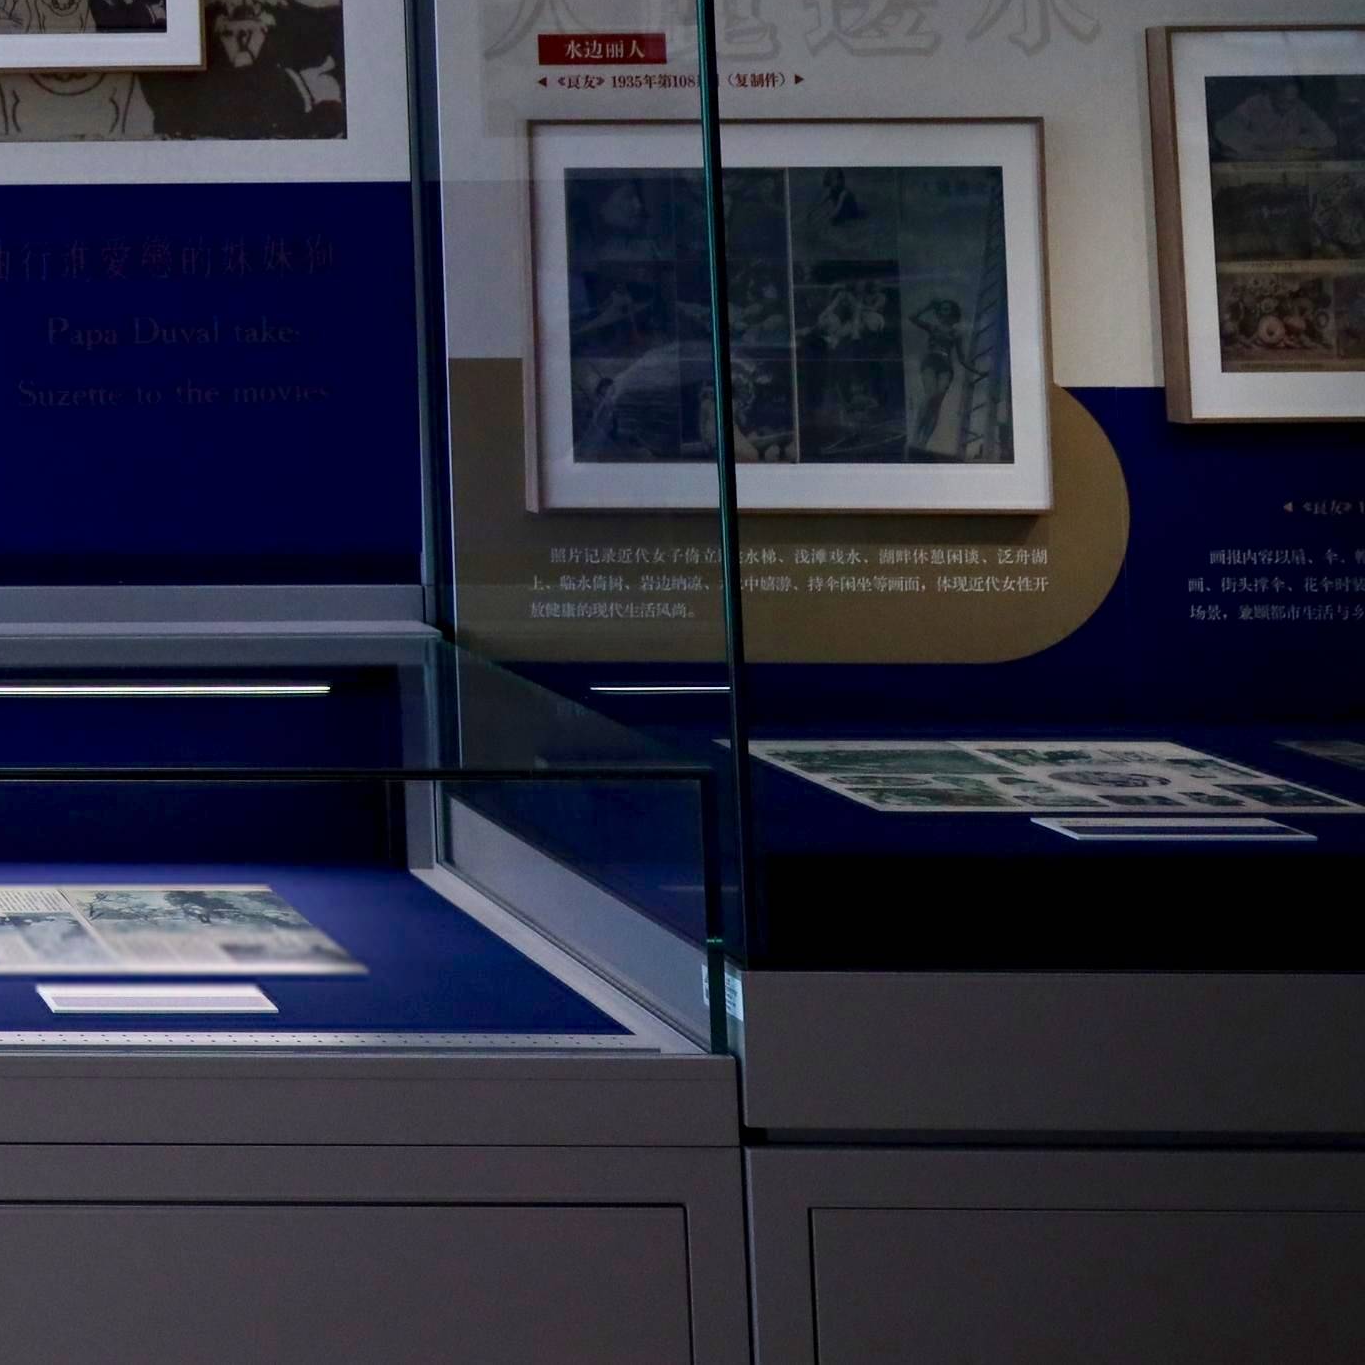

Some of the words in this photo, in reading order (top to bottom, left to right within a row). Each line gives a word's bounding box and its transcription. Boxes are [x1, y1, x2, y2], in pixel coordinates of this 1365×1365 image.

[565, 40, 646, 59] 水边丽人
[46, 315, 119, 352] Papa
[132, 314, 220, 346] Duval
[14, 378, 120, 409] Suzette
[133, 384, 163, 405] to
[174, 378, 220, 405] the
